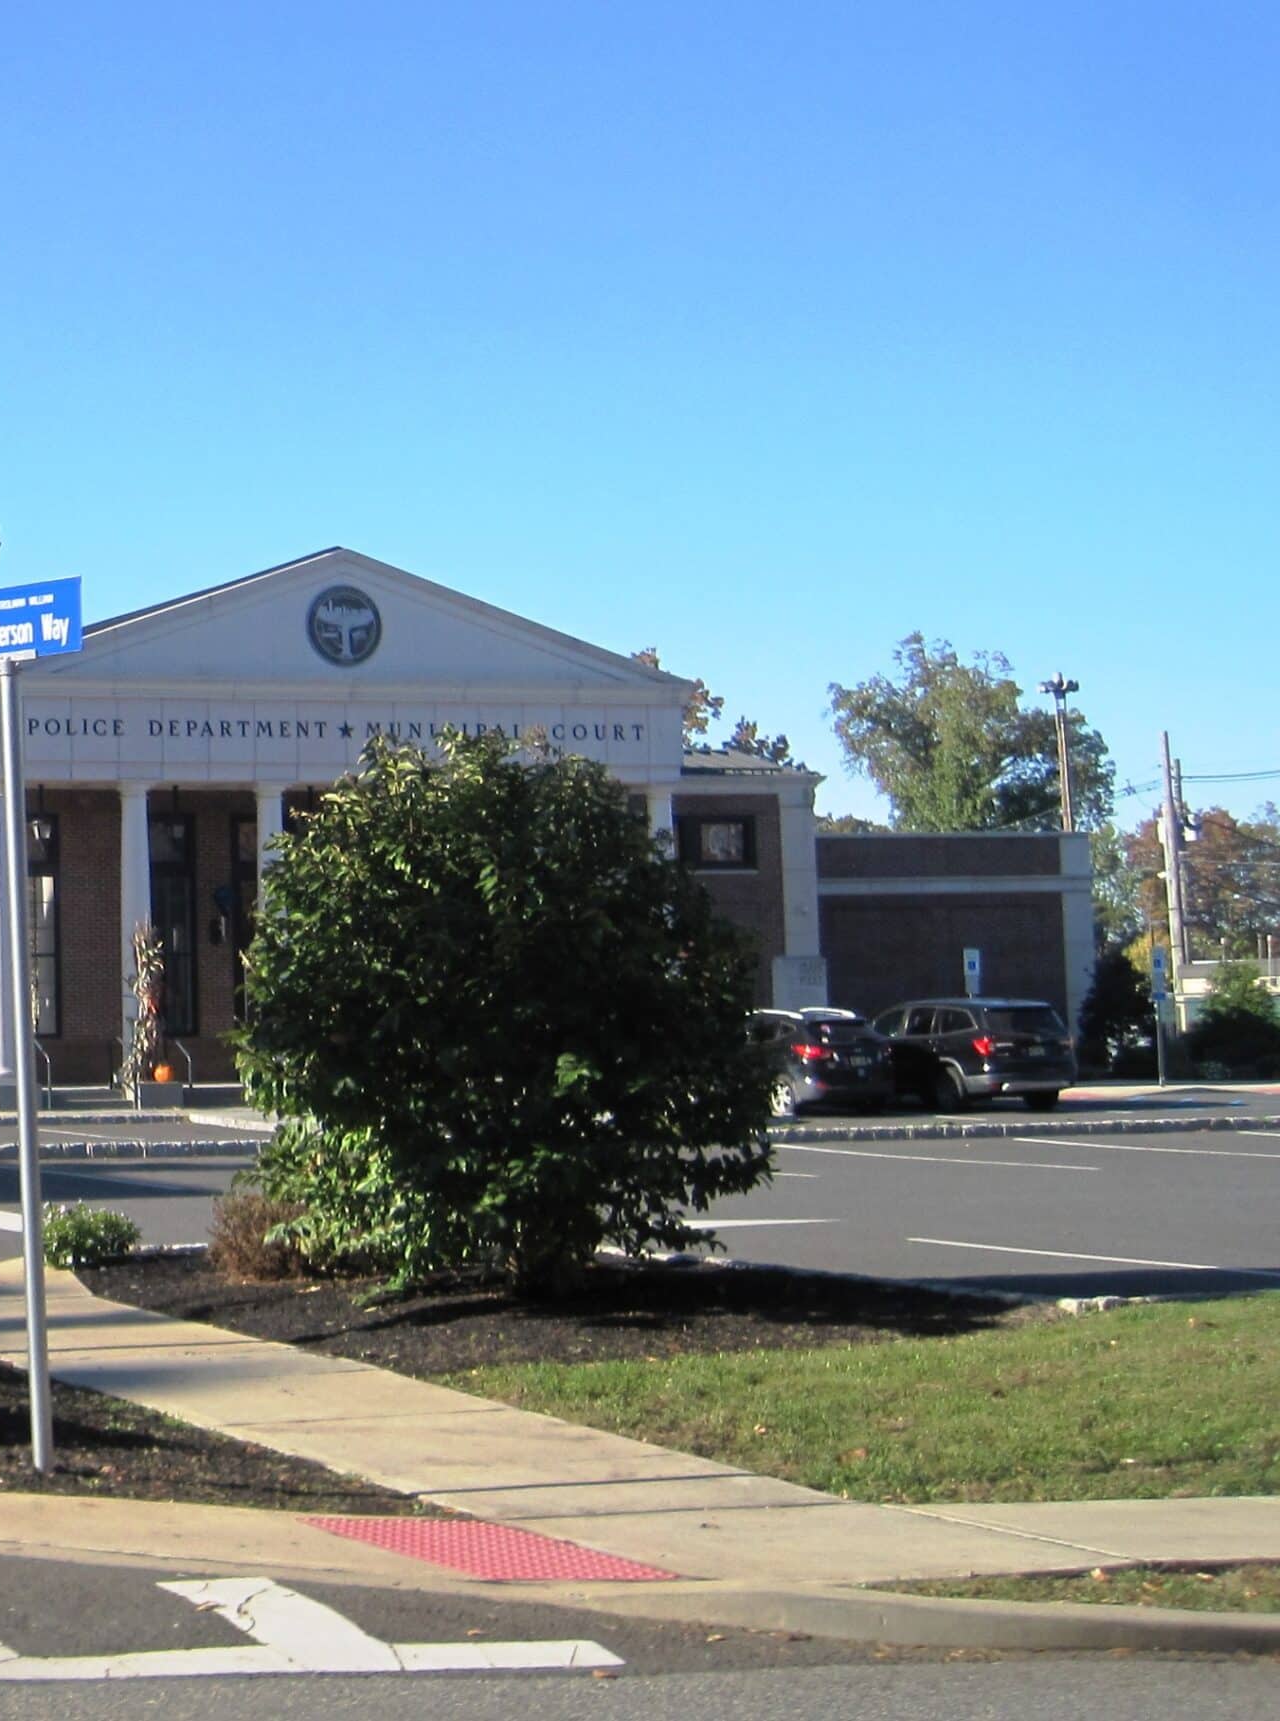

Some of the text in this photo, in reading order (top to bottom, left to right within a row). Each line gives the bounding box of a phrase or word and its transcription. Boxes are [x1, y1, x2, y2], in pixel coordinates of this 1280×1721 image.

[41, 613, 69, 647] Way
[27, 718, 645, 742] POLICE DEPARTMENT MUNIIPA COURT
